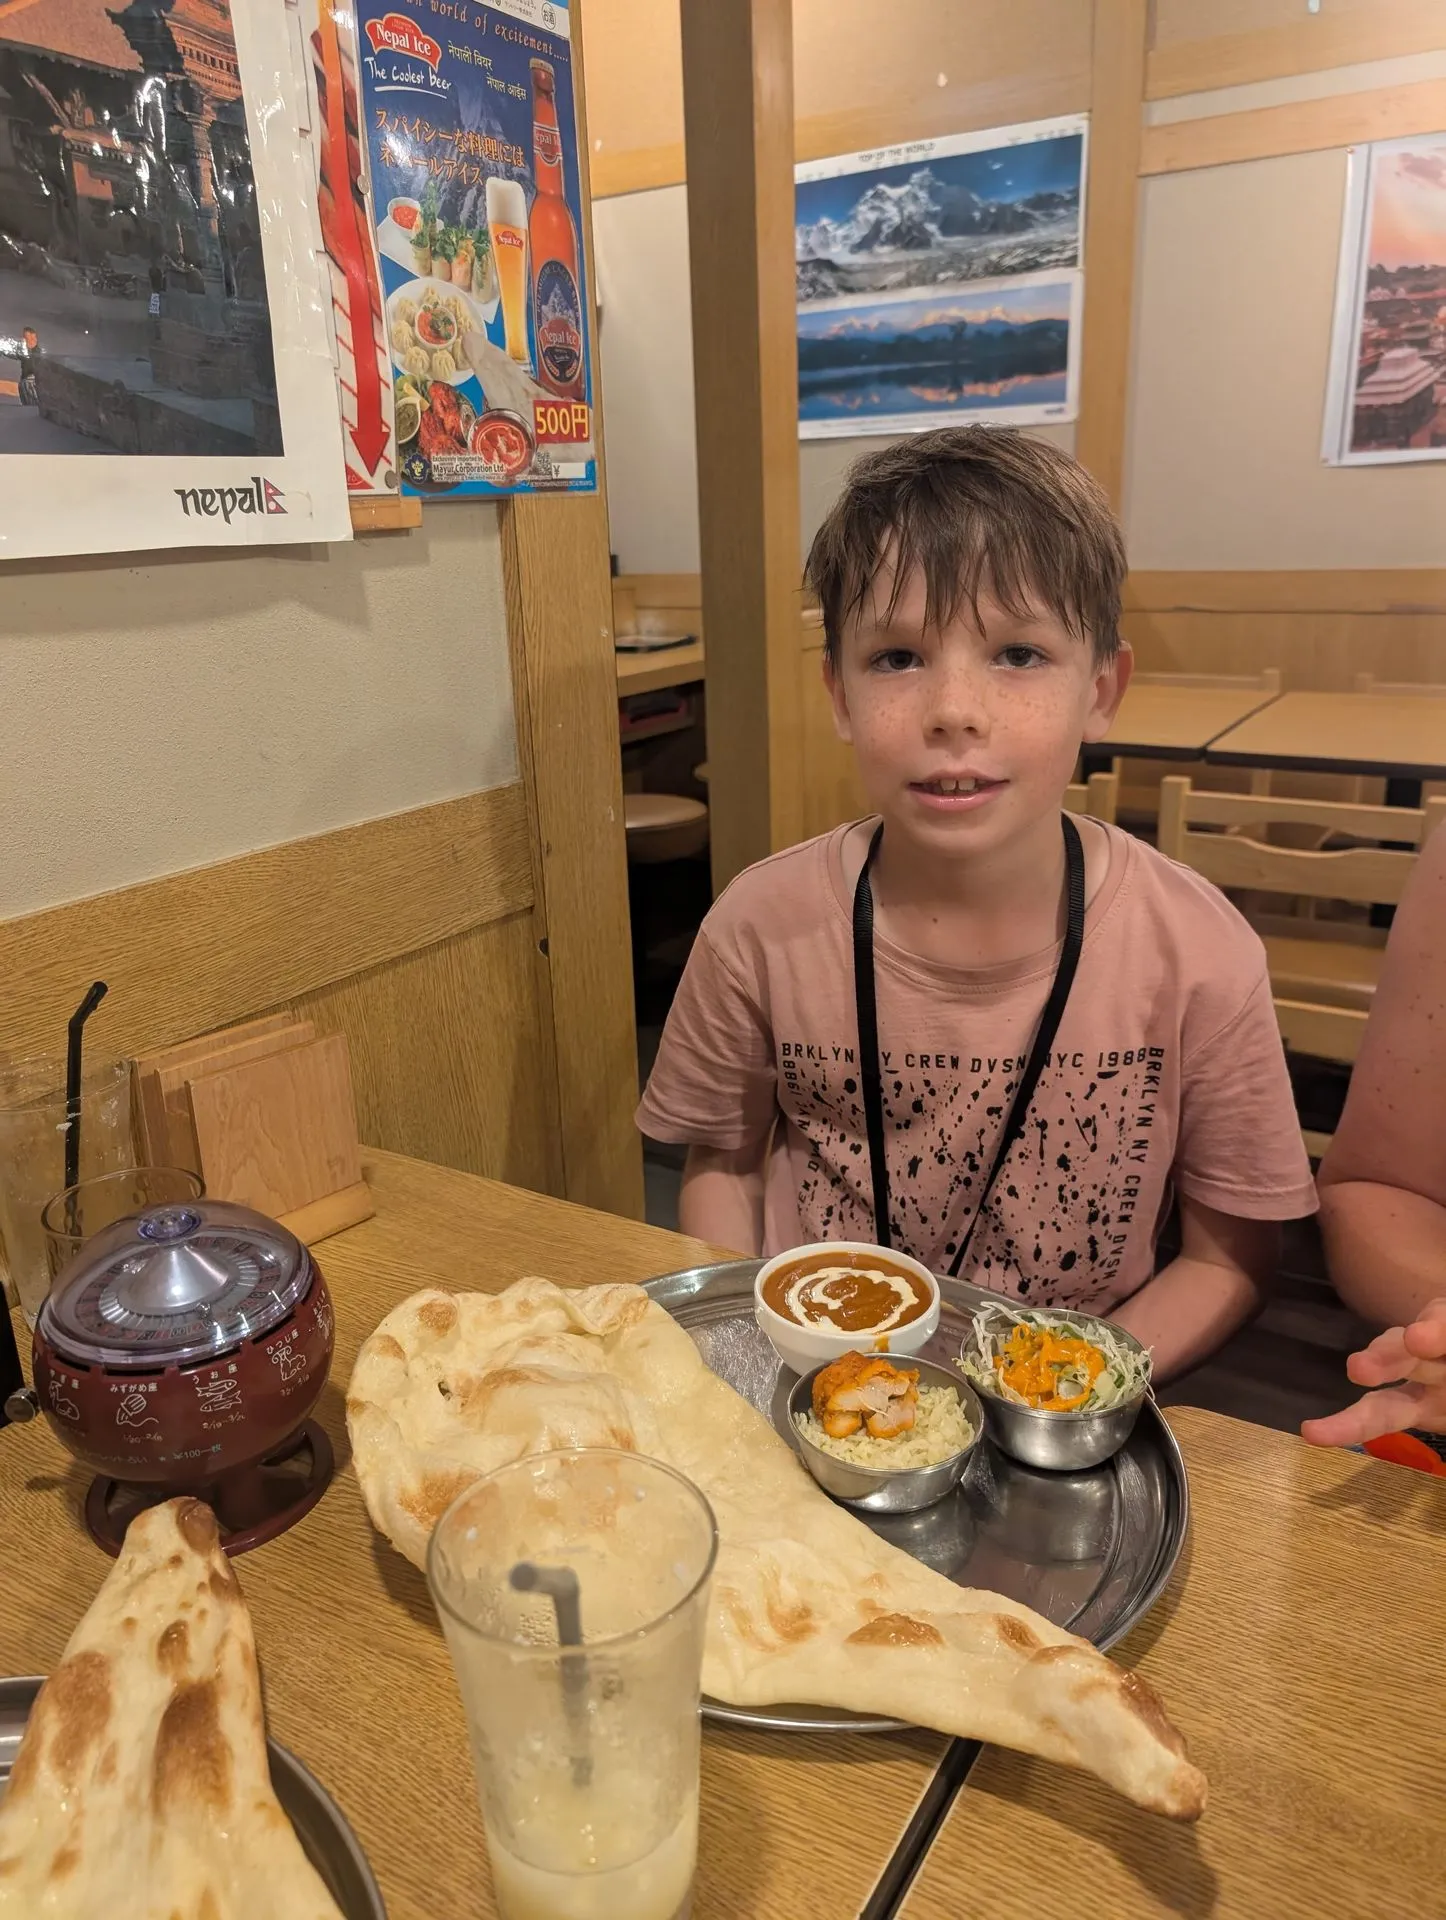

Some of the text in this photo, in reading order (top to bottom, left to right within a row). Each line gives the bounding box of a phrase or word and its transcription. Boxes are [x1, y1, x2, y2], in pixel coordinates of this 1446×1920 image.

[431, 0, 468, 23] world
[475, 12, 488, 35] of
[376, 24, 410, 50] Nepal
[413, 36, 432, 56] Ice
[364, 57, 452, 91] The Coolest beer
[376, 109, 526, 168] スパイシーな料理には
[544, 328, 564, 345] Nepal
[536, 404, 588, 439] 500円
[455, 464, 493, 474] Corporation
[553, 465, 560, 476] ¥
[174, 477, 264, 525] nepal
[782, 1043, 854, 1063] BRKLYN
[905, 1053, 960, 1070] CREW
[970, 1055, 1027, 1073] DVSN
[1098, 1047, 1147, 1068] 1988
[783, 1060, 803, 1096] 1988
[1136, 1047, 1165, 1127] BRKLYN
[1129, 1139, 1149, 1163] NY
[1117, 1174, 1141, 1223] CREW
[110, 1382, 158, 1394] みずがめ座
